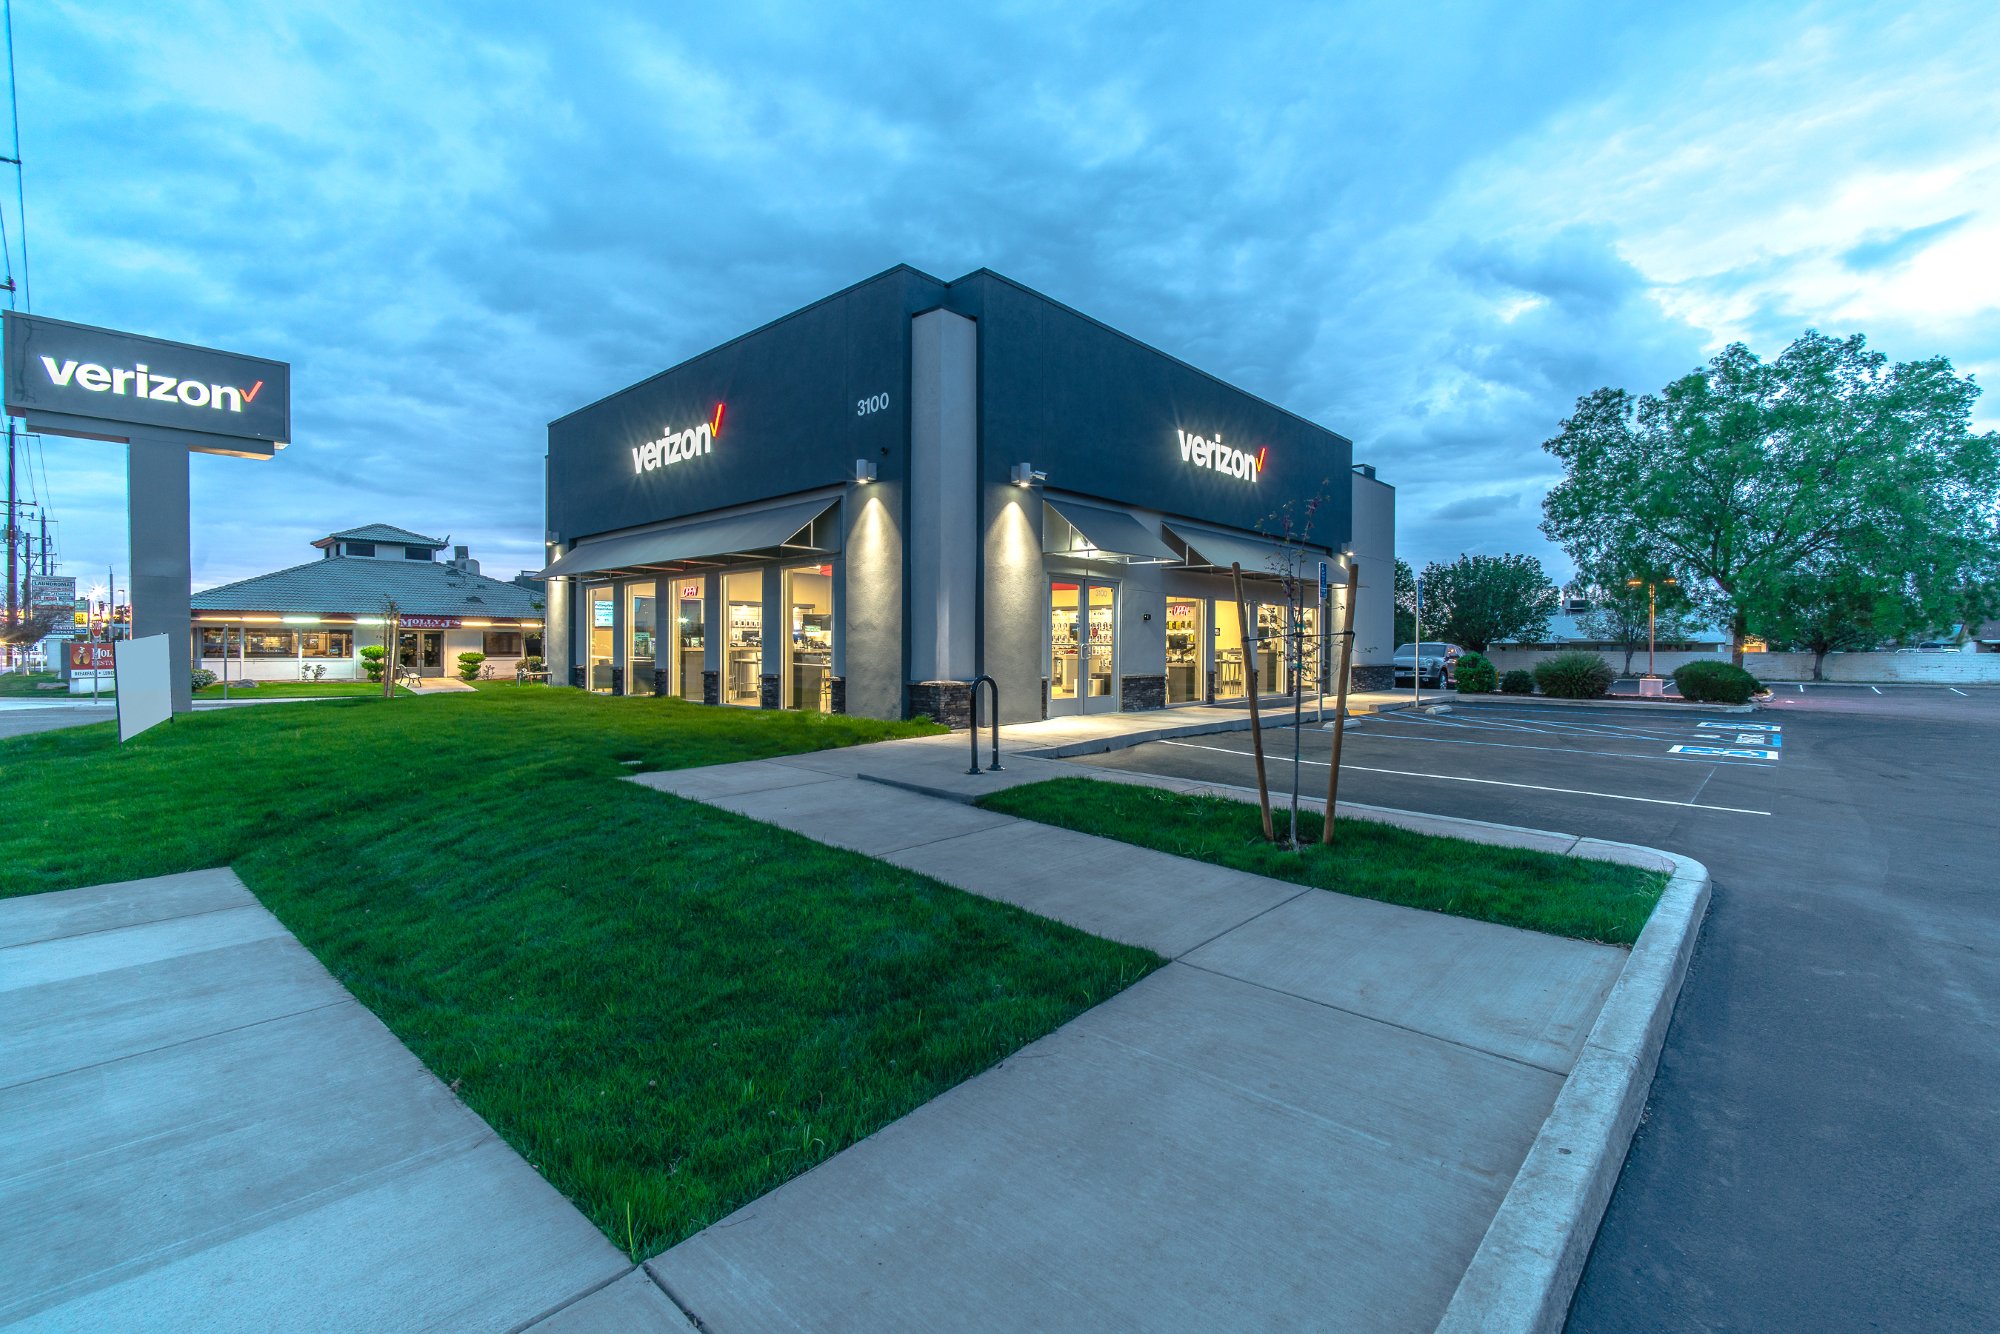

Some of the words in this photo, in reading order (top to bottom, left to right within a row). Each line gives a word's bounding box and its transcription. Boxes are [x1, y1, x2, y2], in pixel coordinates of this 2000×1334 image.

[40, 355, 242, 412] verizon
[857, 392, 889, 416] 3100
[632, 422, 711, 474] verizon
[1178, 429, 1257, 482] verizon
[683, 586, 698, 597] OPEN
[399, 618, 441, 627] MOLLY
[1174, 605, 1189, 616] OPEN
